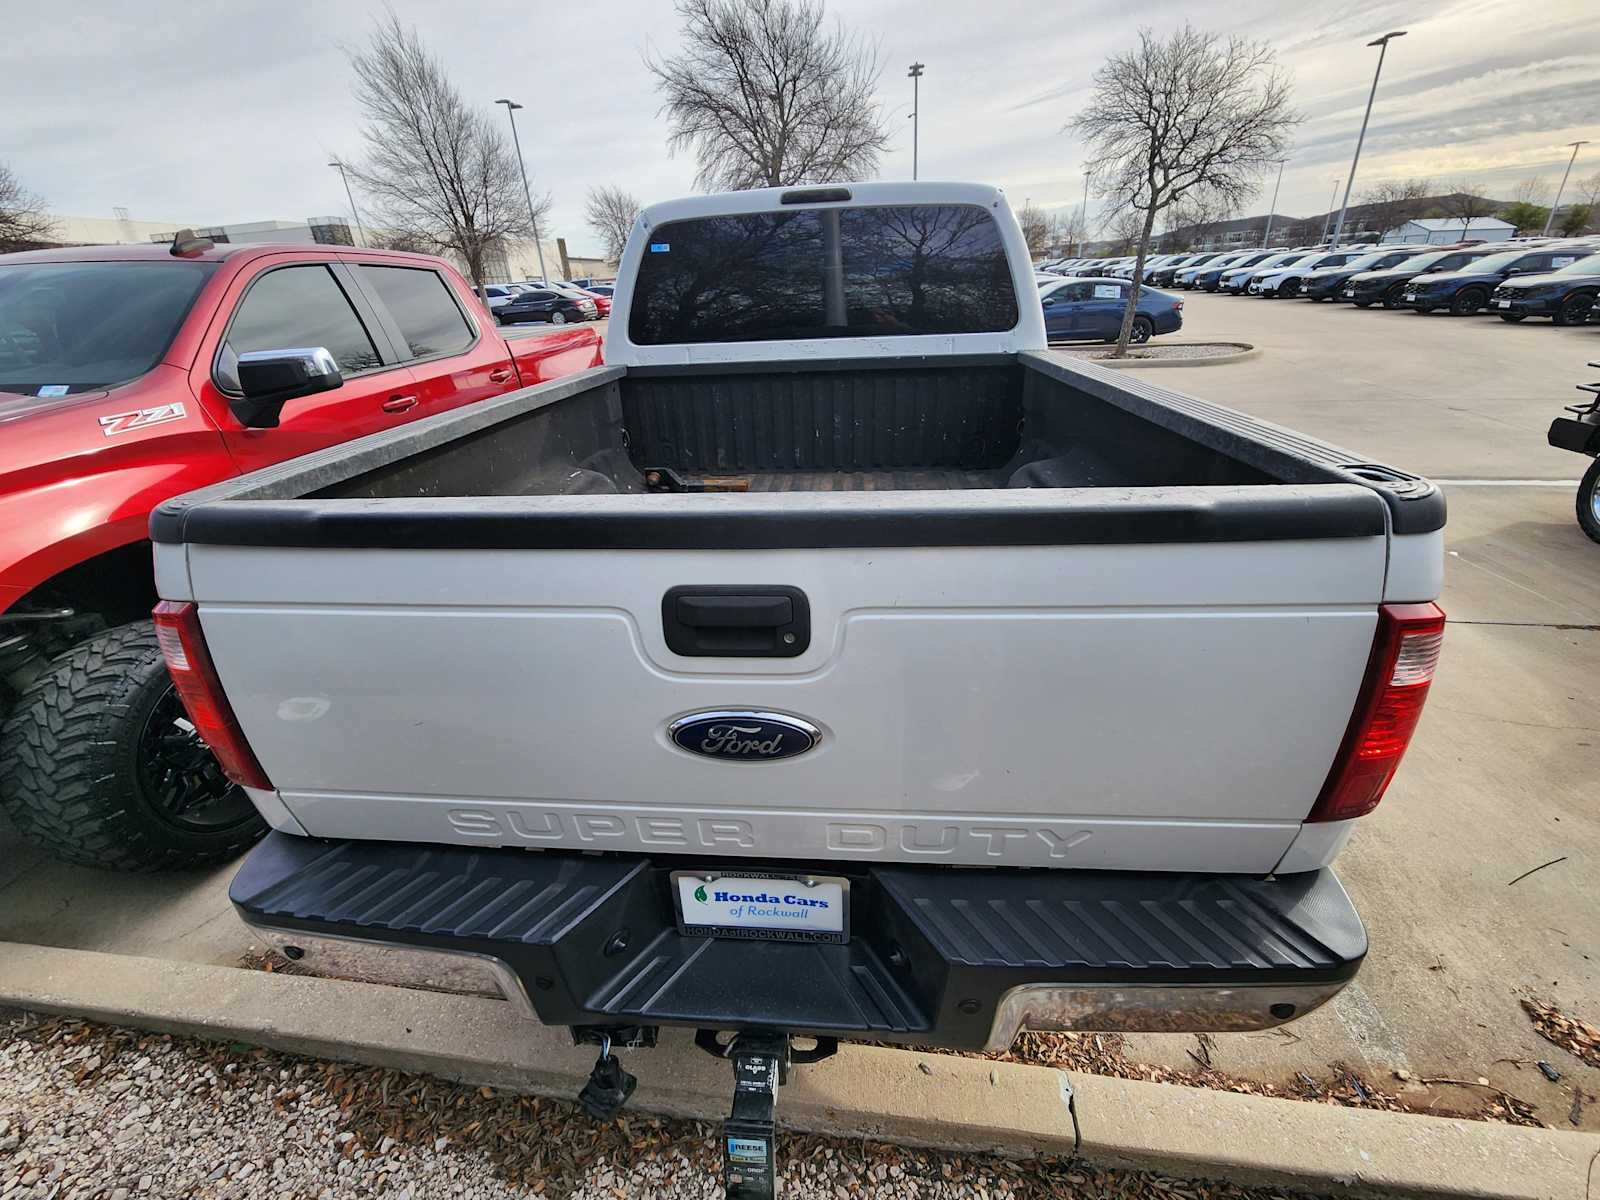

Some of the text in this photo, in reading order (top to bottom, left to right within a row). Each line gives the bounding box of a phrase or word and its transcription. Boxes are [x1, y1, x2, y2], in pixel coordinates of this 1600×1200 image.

[701, 724, 784, 754] Ford
[448, 808, 1093, 858] SUPER DUTY
[714, 891, 829, 909] Honda Cars
[729, 905, 808, 919] of Rockwall
